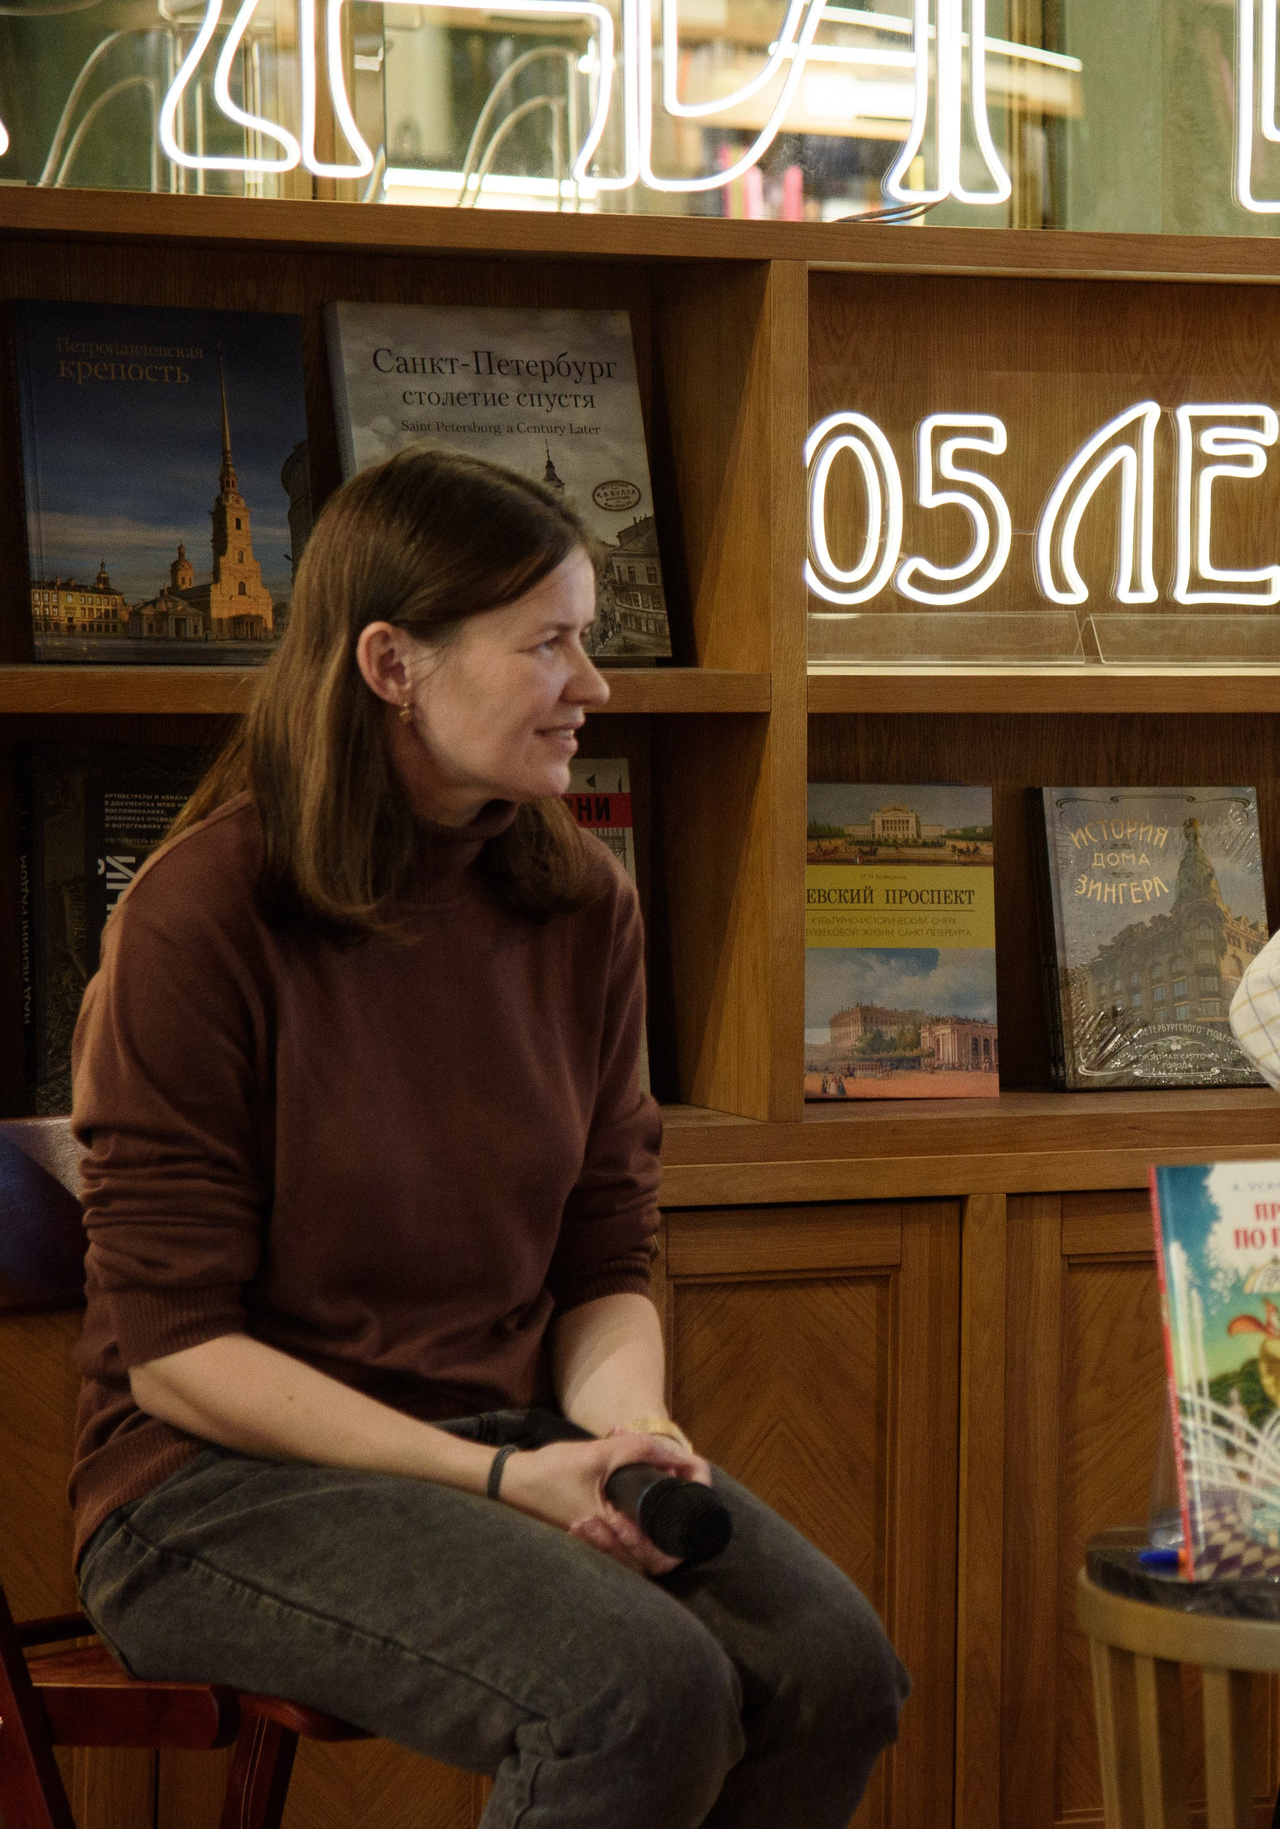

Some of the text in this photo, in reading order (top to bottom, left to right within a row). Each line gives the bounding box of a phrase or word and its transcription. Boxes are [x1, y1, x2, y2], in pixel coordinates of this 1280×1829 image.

[56, 336, 204, 359] Петропавловская
[59, 360, 190, 386] крепость
[372, 348, 617, 384] Санкт-Петербург
[402, 390, 596, 413] столетие спустя
[401, 421, 431, 433] Saint
[507, 426, 514, 434] a
[517, 423, 566, 437] Century
[569, 423, 600, 435] Later
[805, 411, 1011, 606] 05
[563, 796, 611, 822] НИ
[1070, 819, 1169, 850] ИСТОРИЯ
[1091, 852, 1151, 869] ДОМА
[806, 885, 975, 905] ЕВСКИЙ ПРОСПЕКТ
[1074, 874, 1170, 904] ЗИНГЕРА
[19, 854, 32, 1025] НАД ЛЕНИНГРАДОМ
[862, 927, 894, 937] ЖИЗНИ
[898, 928, 972, 938] САНКТ-ПЕТЕРБУРГА
[1233, 1228, 1267, 1250] ПО
